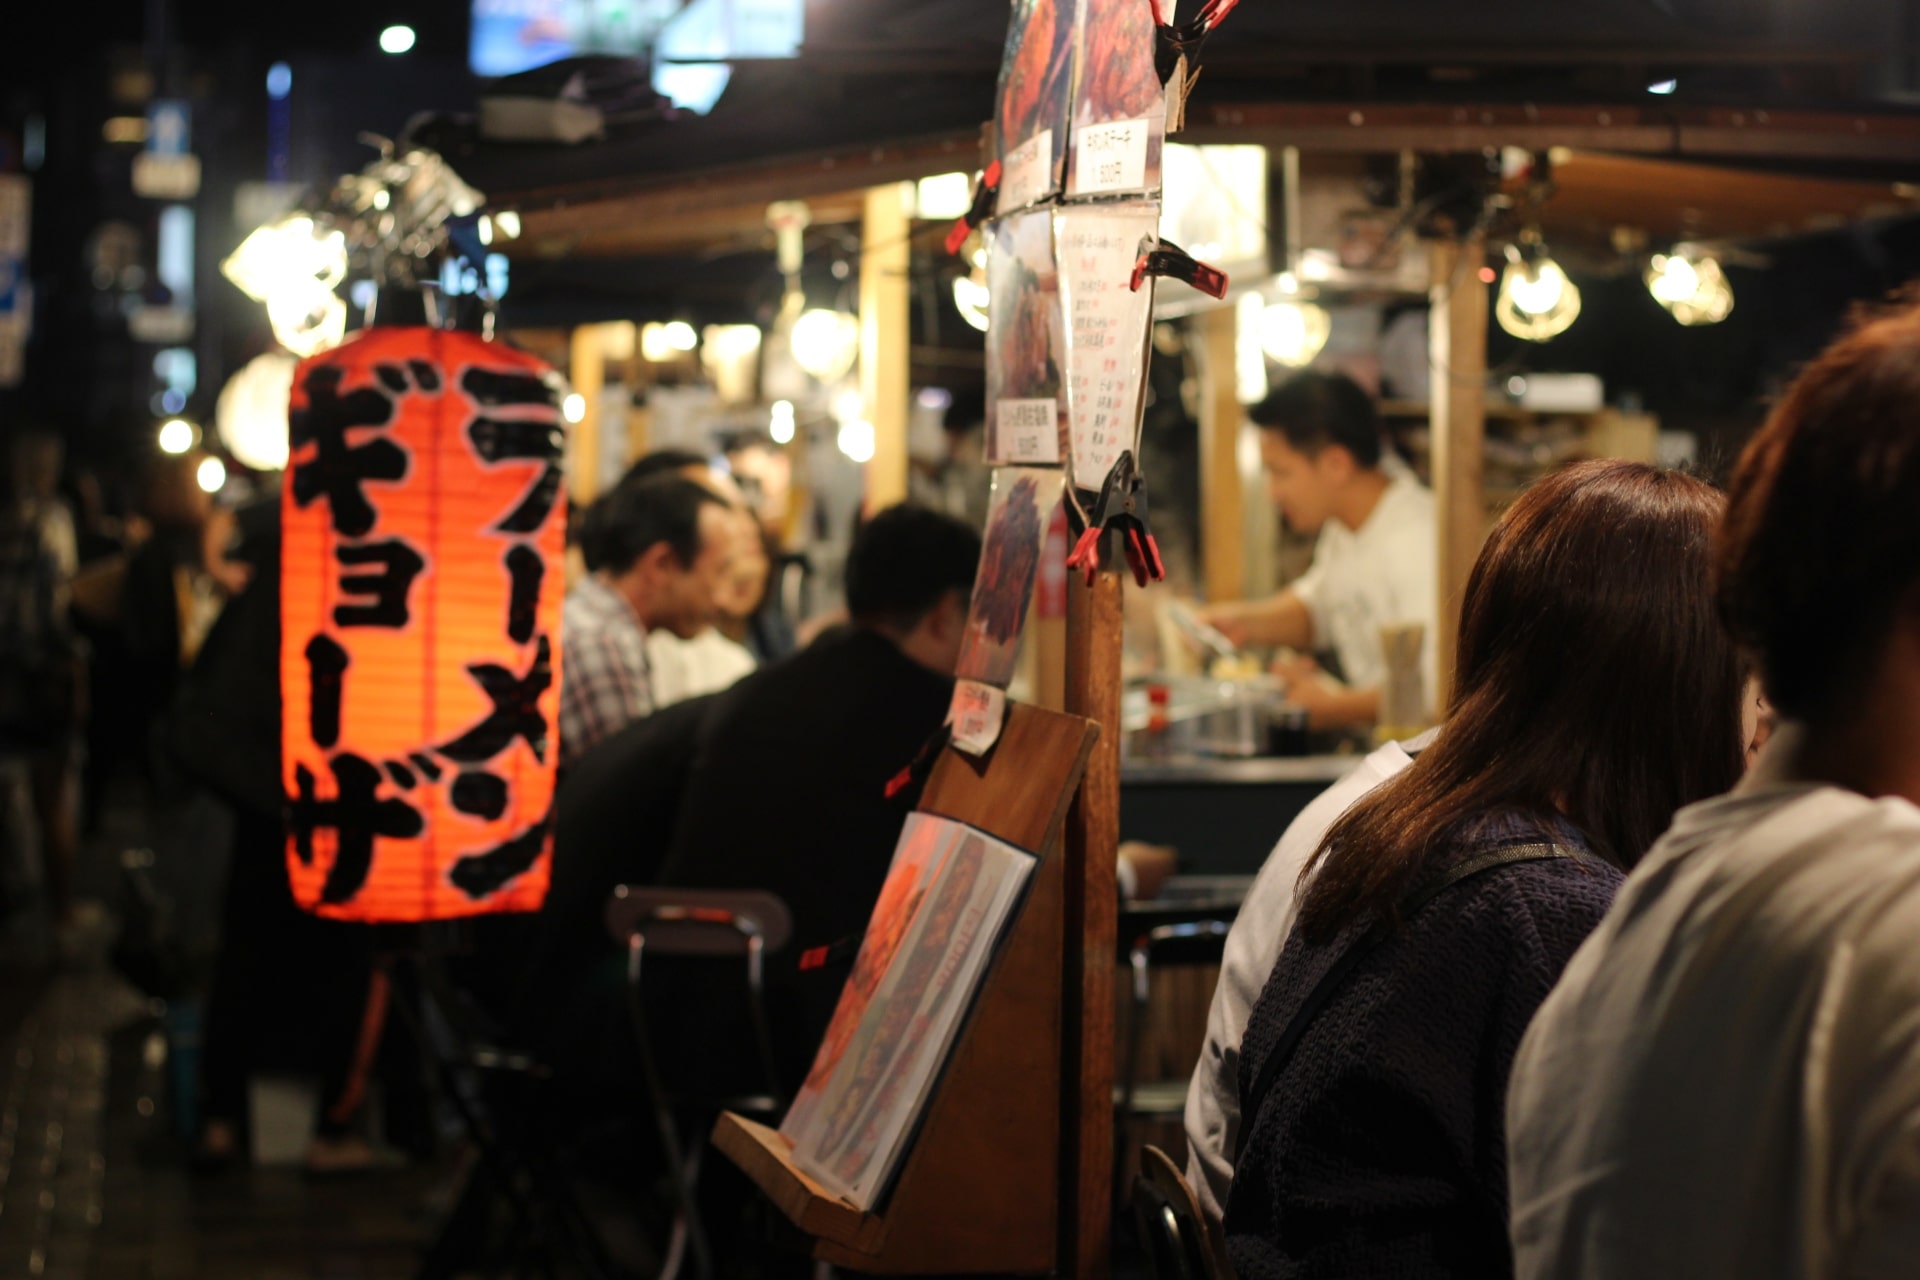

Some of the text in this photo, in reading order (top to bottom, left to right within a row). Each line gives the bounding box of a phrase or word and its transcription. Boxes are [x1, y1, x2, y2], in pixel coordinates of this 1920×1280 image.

[288, 359, 443, 902] ギョーザ
[436, 364, 563, 900] ラーメン
